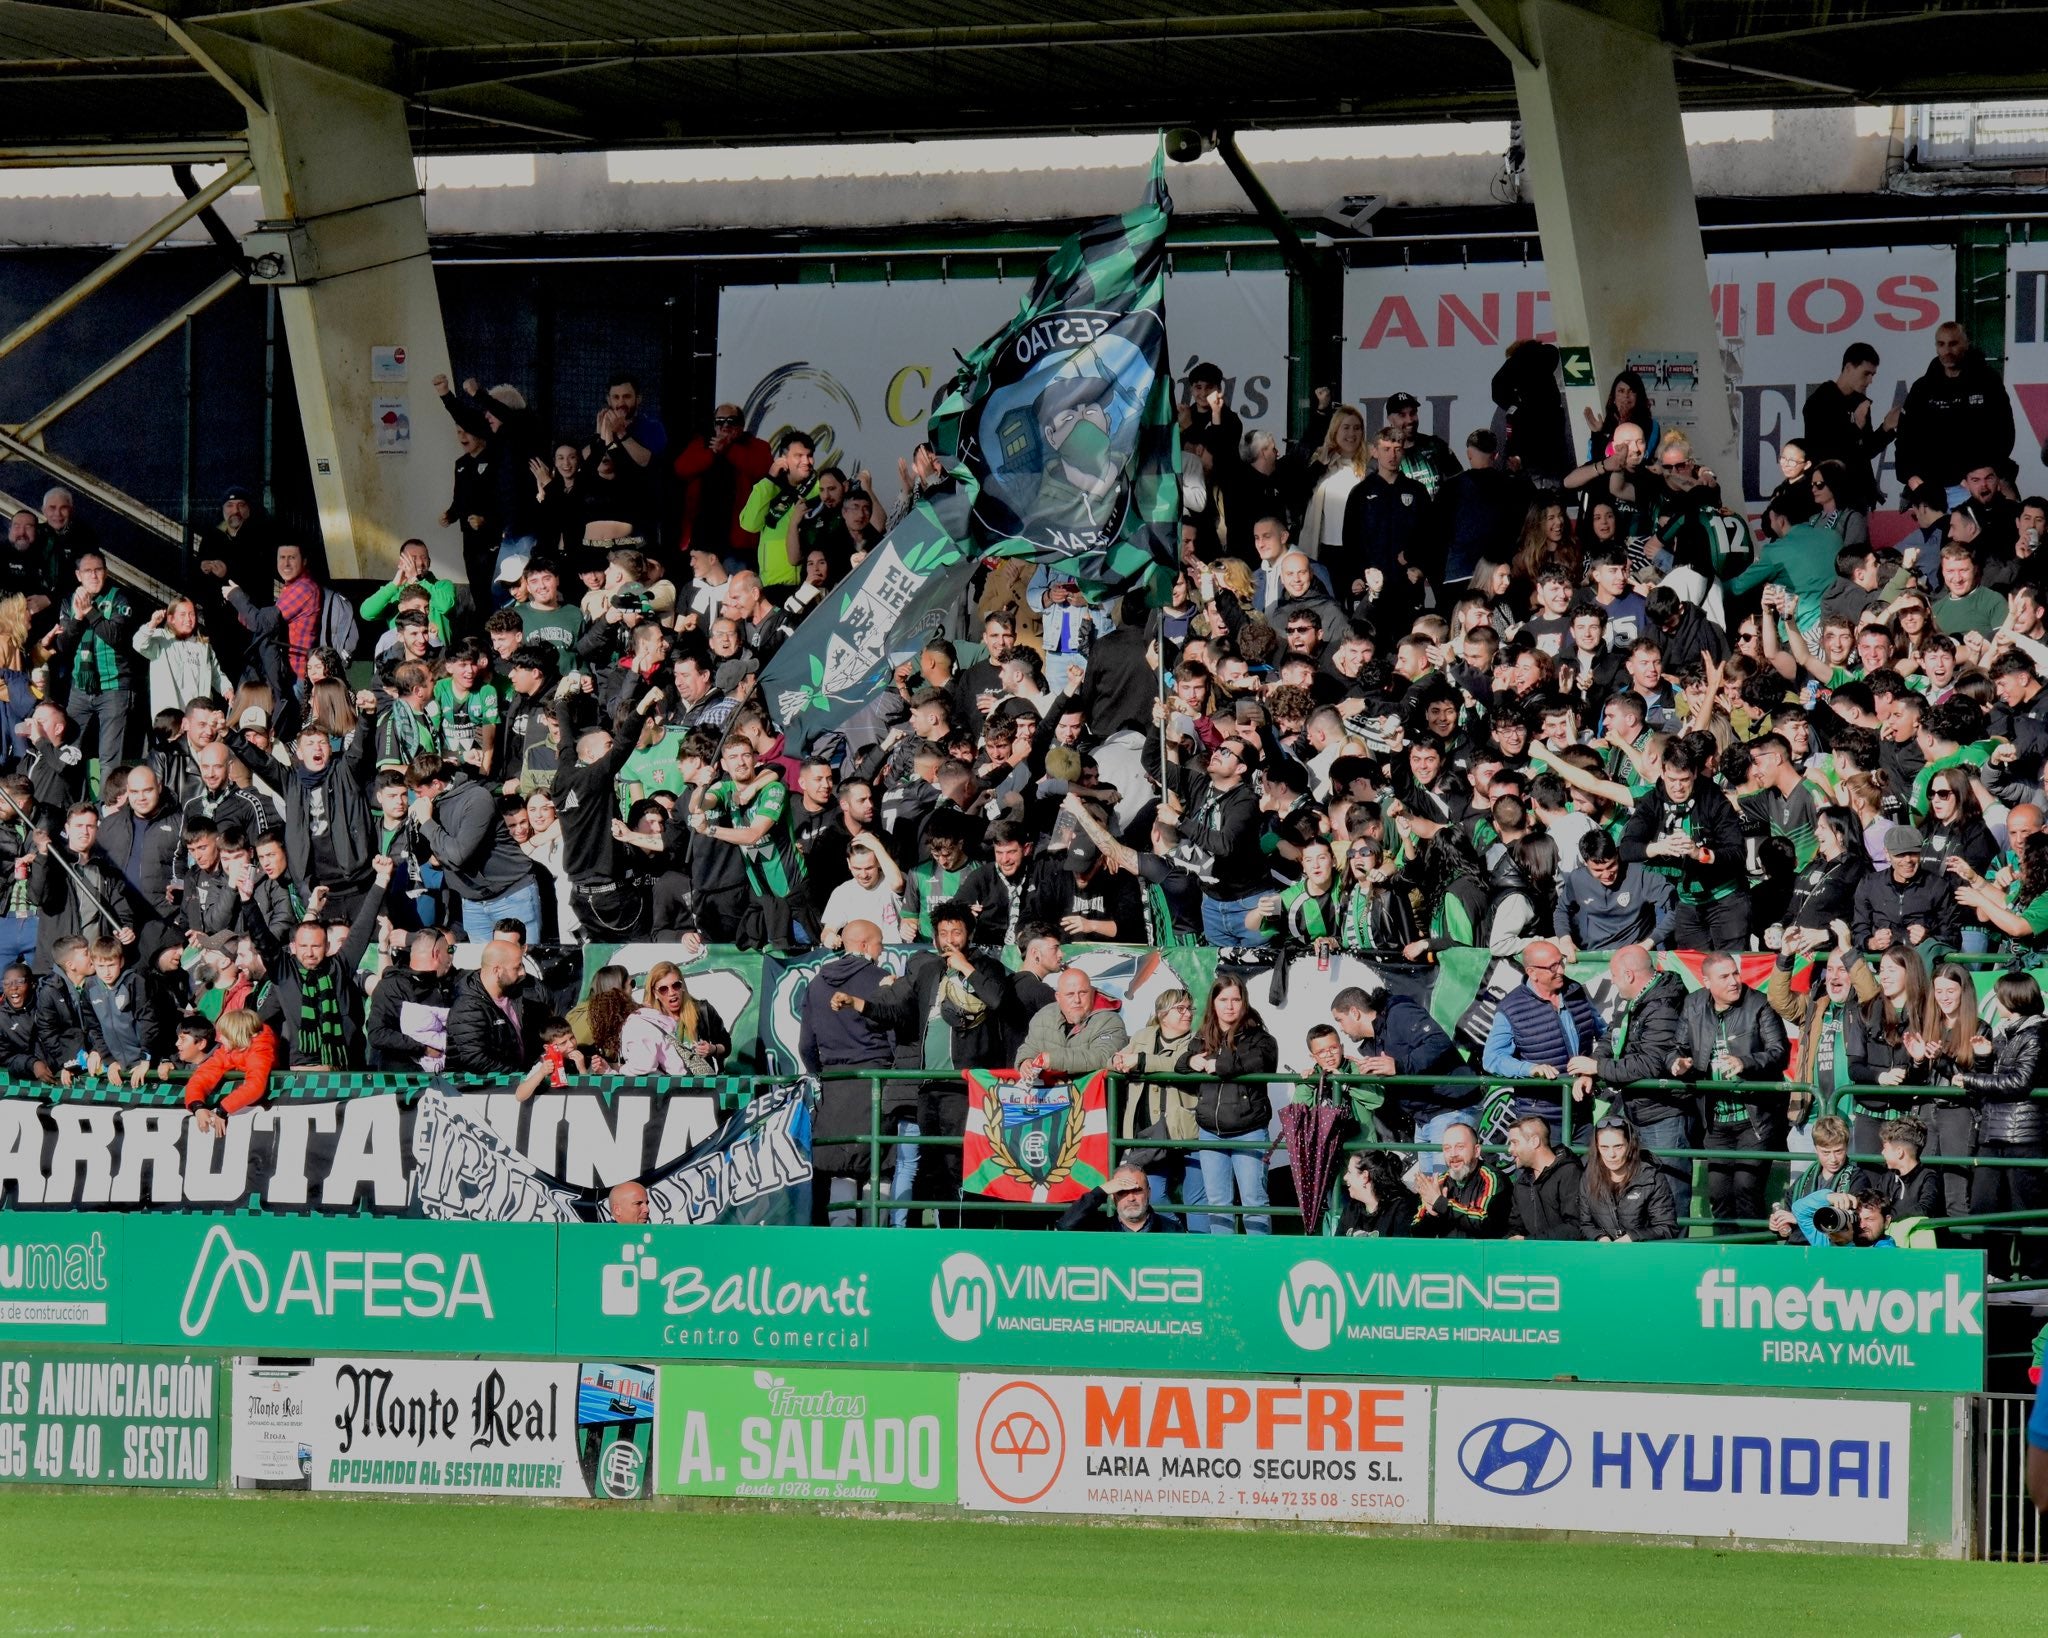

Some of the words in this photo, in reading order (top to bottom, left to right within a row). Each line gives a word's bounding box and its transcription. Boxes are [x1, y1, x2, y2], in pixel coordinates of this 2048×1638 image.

[1709, 516, 1749, 554] 12
[541, 627, 574, 647] ANGELES
[275, 1250, 495, 1319] AFESA
[661, 1266, 871, 1317] Ballonti
[7, 1304, 21, 1320] de
[24, 1304, 89, 1321] construcción
[1695, 1268, 1984, 1335] finetwork
[664, 1325, 740, 1345] Centro
[754, 1327, 870, 1348] Comercial
[997, 1317, 1094, 1333] MANGUERAS
[1098, 1319, 1202, 1335] HIDRAULICAS
[1347, 1325, 1449, 1341] MANGUERAS
[1453, 1327, 1560, 1344] HIDRAULICAS
[1762, 1340, 1824, 1363] FIBRA
[1828, 1342, 1842, 1363] Y
[1848, 1339, 1915, 1367] MÓVIL
[37, 1355, 212, 1419] ANUNCIACIÓN
[769, 1386, 866, 1419] Frutas
[249, 1395, 279, 1419] Monte
[282, 1397, 303, 1418] Real
[336, 1364, 459, 1453] Monte
[470, 1366, 559, 1452] Real
[1084, 1386, 1403, 1452] MAPFRE
[33, 1423, 63, 1477] 49
[69, 1424, 100, 1478] 40
[123, 1426, 208, 1481] SESTAO
[678, 1410, 725, 1485] A.
[740, 1414, 940, 1490] SALADO
[1592, 1431, 1890, 1498] HYUNDAI
[328, 1458, 417, 1485] APOYANDO
[419, 1460, 441, 1485] AL
[445, 1462, 504, 1487] SESTAO
[506, 1464, 562, 1489] RIVER!
[1086, 1456, 1149, 1478] LARIA
[1162, 1457, 1240, 1480] MARCO
[1253, 1459, 1356, 1481] SEGUROS
[1368, 1461, 1403, 1483] S.L.
[736, 1480, 774, 1497] desde
[778, 1481, 811, 1497] 1978
[815, 1486, 831, 1497] en
[833, 1482, 878, 1499] Sestao
[1087, 1488, 1155, 1504] MARIANA
[1218, 1491, 1226, 1504] 2
[1253, 1493, 1280, 1506] 944
[1282, 1494, 1299, 1507] 72
[1302, 1494, 1318, 1507] 35
[1321, 1494, 1339, 1508] 08
[1352, 1494, 1404, 1509] SESTAO
